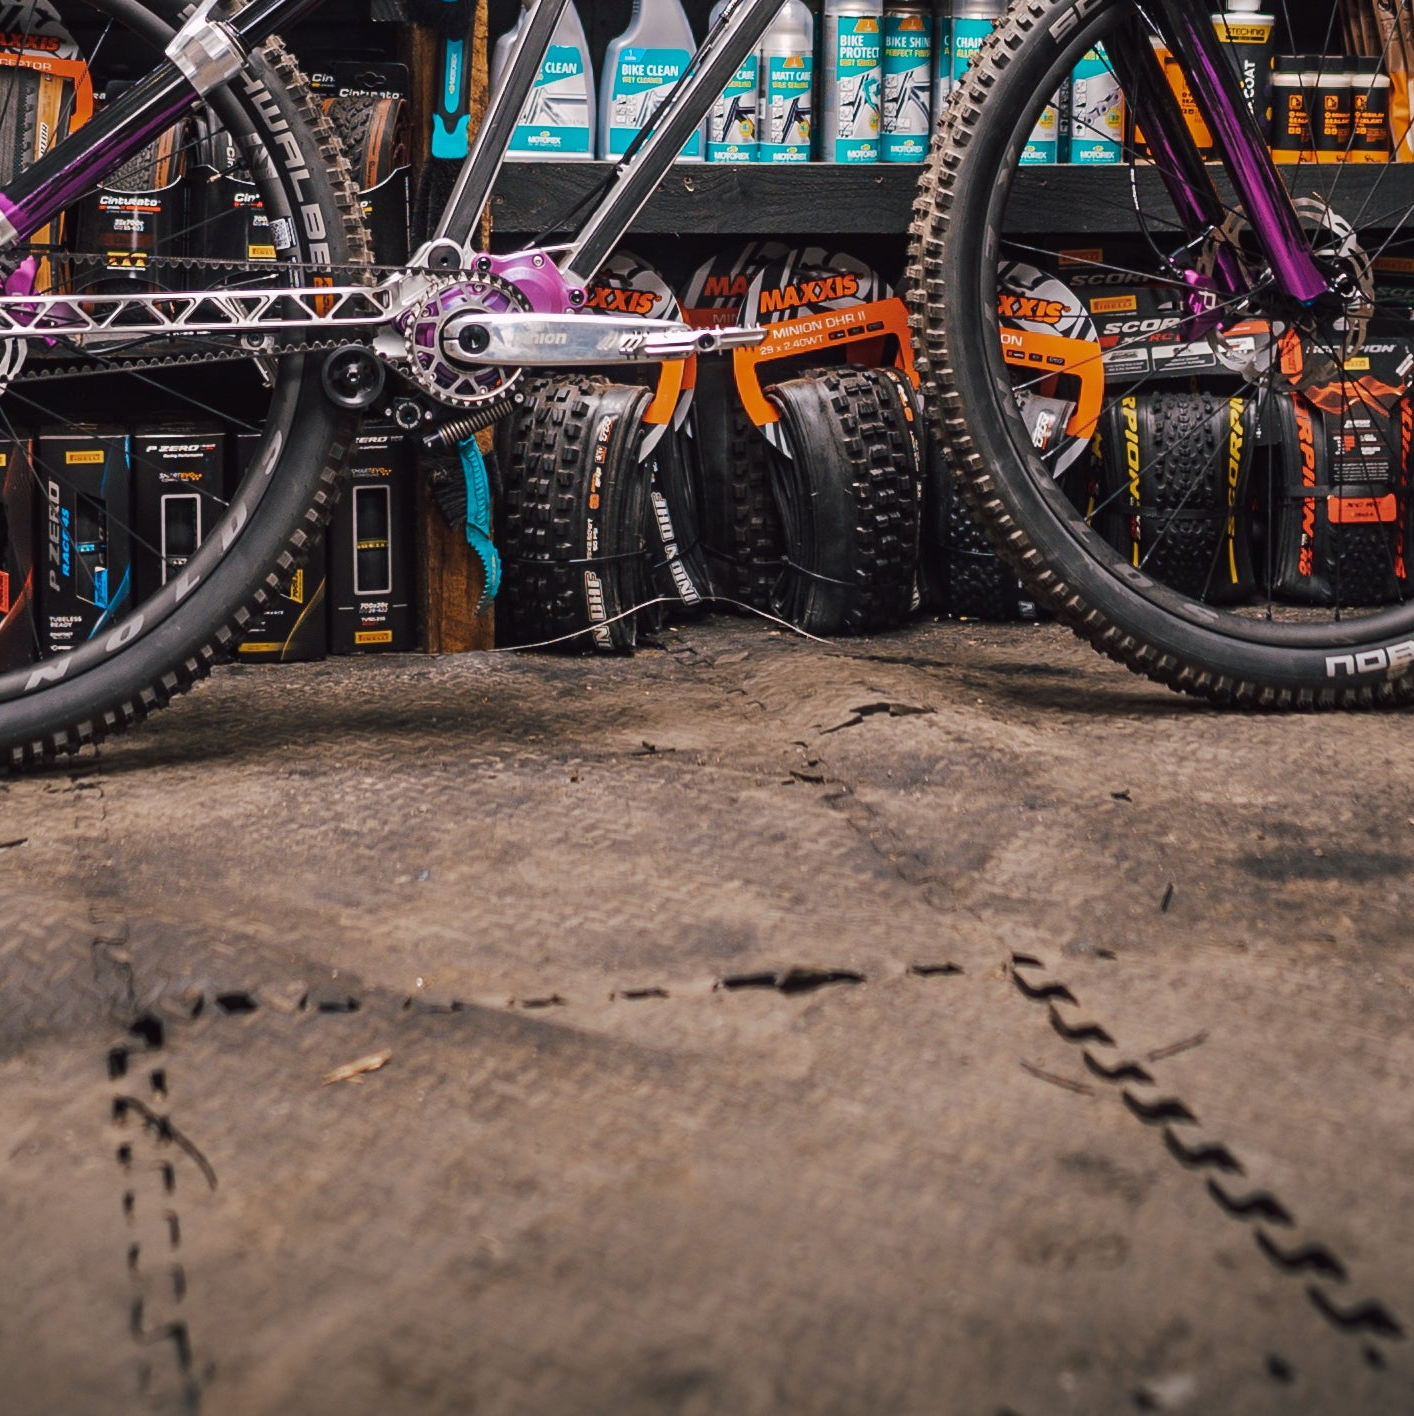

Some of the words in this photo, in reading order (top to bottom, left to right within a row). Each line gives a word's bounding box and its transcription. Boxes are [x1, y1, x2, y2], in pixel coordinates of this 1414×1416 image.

[840, 35, 864, 46] BIKE
[886, 36, 908, 47] BIKE
[840, 47, 880, 59] PROTECT
[545, 62, 578, 74] CLEAN
[621, 64, 645, 76] BIKE
[647, 64, 679, 77] CLEAN
[772, 71, 794, 81] MATT
[528, 135, 562, 144] MOTOREX
[714, 151, 750, 160] MOTOREX
[847, 150, 878, 159] MOTOREX
[891, 145, 923, 154] MOTOREX
[1080, 150, 1114, 159] MOTOREX
[773, 152, 807, 161] MOTOREX
[99, 195, 159, 207] Cinturato
[759, 274, 858, 314] MAXXIS
[1093, 298, 1135, 311] PIRELLI
[773, 320, 823, 340] MINION
[826, 314, 855, 328] DHR
[858, 311, 866, 322] II
[759, 346, 774, 357] 29
[776, 344, 783, 352] x
[784, 335, 825, 351] 2.40WT
[146, 444, 157, 453] P
[158, 444, 199, 453] ZERO
[69, 454, 101, 463] PIRELLI
[48, 480, 61, 567] ZERO
[61, 505, 71, 531] 4S
[651, 491, 676, 544] DHF
[48, 570, 61, 592] P
[585, 570, 607, 623] DHF
[358, 634, 389, 643] PIRELLI
